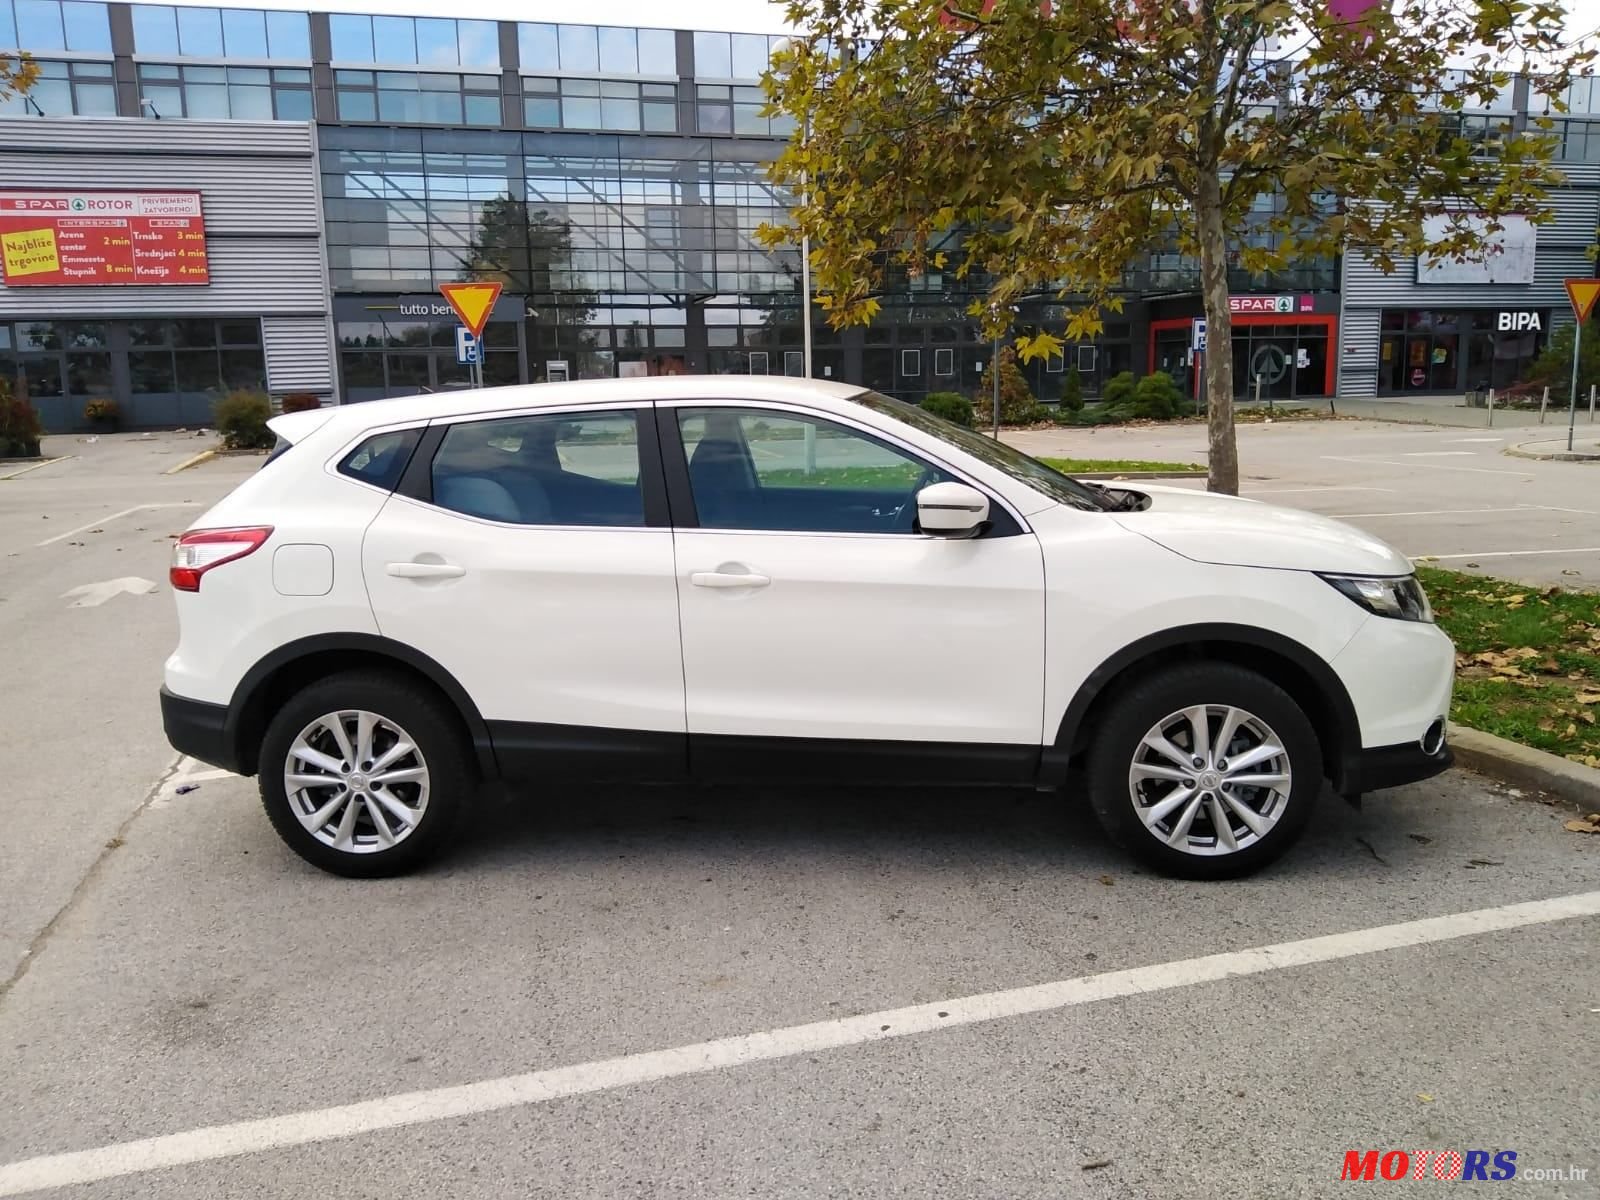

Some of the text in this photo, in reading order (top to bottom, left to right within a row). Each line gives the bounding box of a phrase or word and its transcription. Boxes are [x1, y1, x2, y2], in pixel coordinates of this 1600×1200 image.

[15, 199, 133, 209] SPAR ROTOR
[59, 231, 84, 239] Arena
[133, 232, 203, 240] Trnsko 3 min
[6, 238, 53, 254] Najbliže
[104, 237, 130, 246] 2 min
[135, 249, 206, 260] Srednjaci 4 min
[9, 253, 55, 270] trgovine
[64, 267, 96, 277] Stupnik
[106, 264, 133, 273] 8 min
[136, 266, 206, 277] Knežija 4 min
[400, 303, 428, 315] tutto
[1230, 299, 1275, 310] SPAR
[1498, 312, 1541, 331] BIPA
